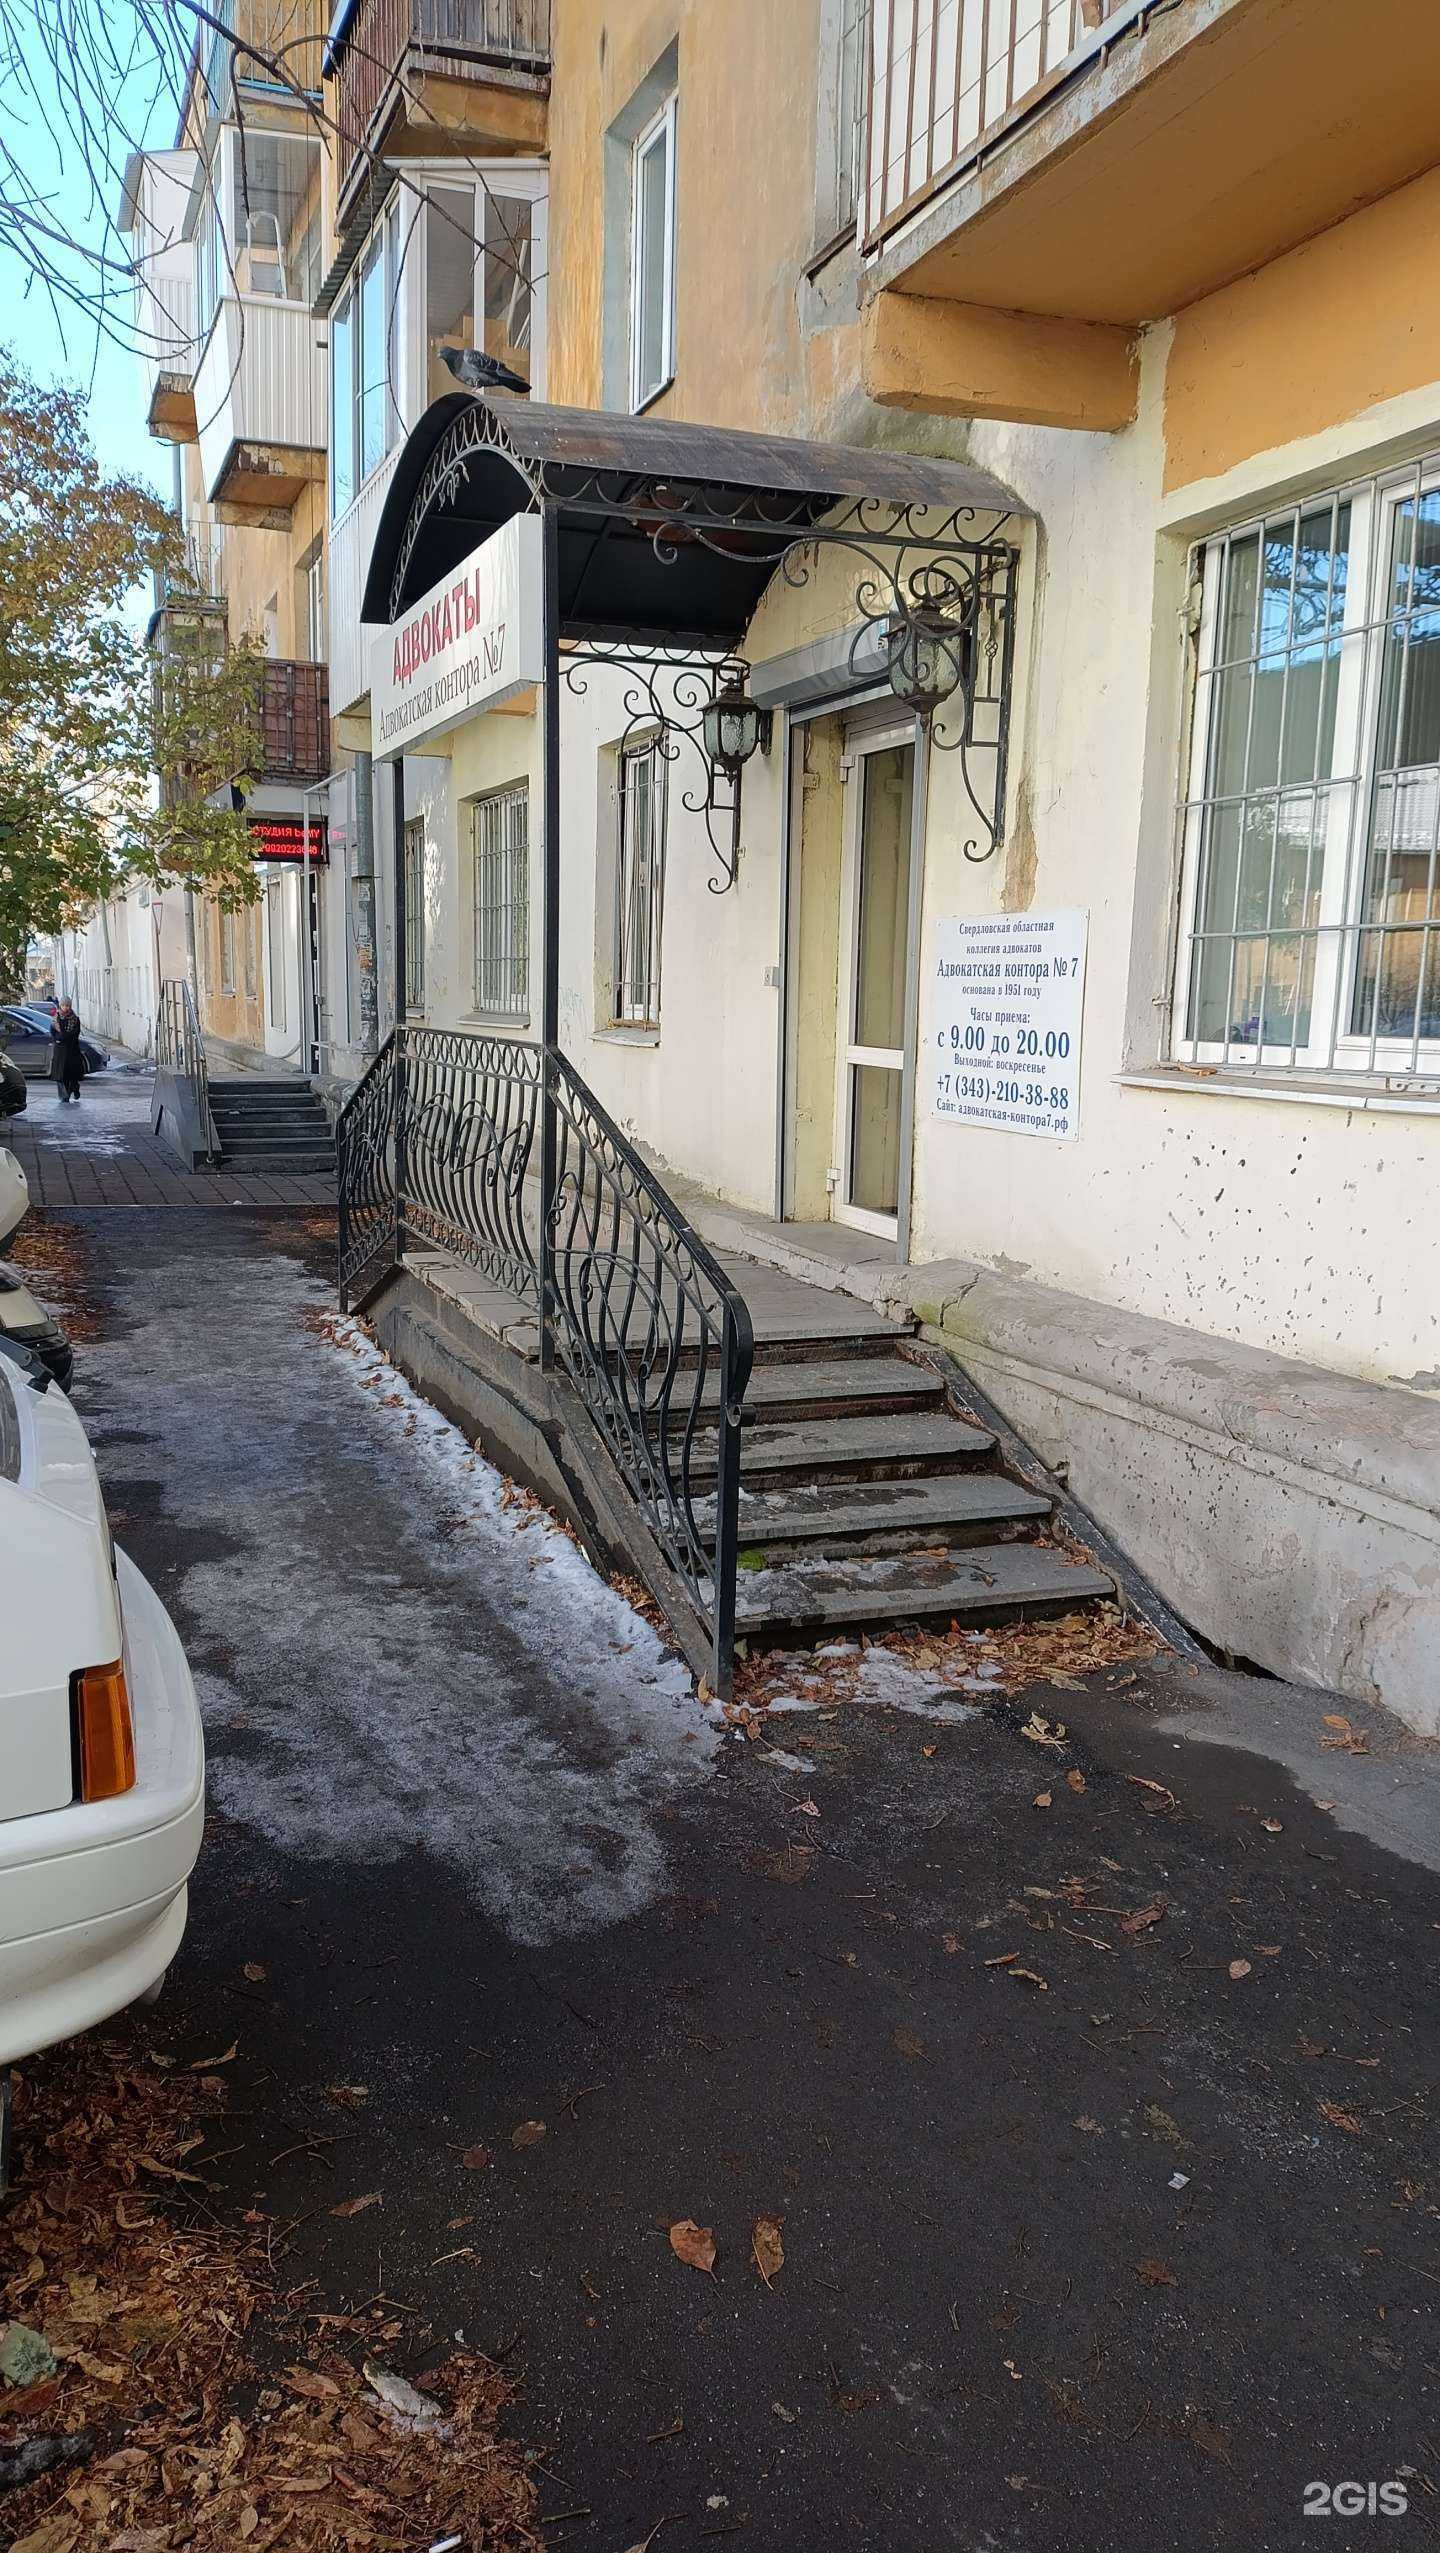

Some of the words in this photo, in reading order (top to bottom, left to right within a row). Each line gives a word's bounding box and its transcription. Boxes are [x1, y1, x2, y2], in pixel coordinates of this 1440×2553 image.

[393, 568, 480, 689] АДВОКАТЫ
[379, 684, 433, 742] Адвокатская
[435, 656, 480, 705] контора
[483, 623, 506, 680] №7
[959, 922, 1010, 937] Свердловская
[1013, 921, 1054, 932] областная
[966, 944, 1000, 954] коллегия
[1002, 943, 1042, 954] адвокатов
[937, 959, 1000, 978] Адвокатская
[1004, 962, 1049, 982] контора
[962, 985, 995, 995] основана
[998, 986, 1002, 995] в
[1004, 984, 1021, 996] 1951
[1023, 986, 1042, 999] году
[970, 1007, 992, 1022] Часы
[995, 1011, 1030, 1026] приема:
[937, 1031, 945, 1048] с
[951, 1025, 985, 1051] 9.00
[990, 1035, 1010, 1056] до
[1016, 1029, 1070, 1058] 20.00
[954, 1053, 994, 1069] Выходной:
[996, 1058, 1046, 1074] воскресенье
[937, 1074, 951, 1093] +7
[955, 1075, 1069, 1110] (343)-210-38-88
[936, 1097, 956, 1113] Сайт:
[958, 1104, 1068, 1133] адвокатская-контора7.рф
